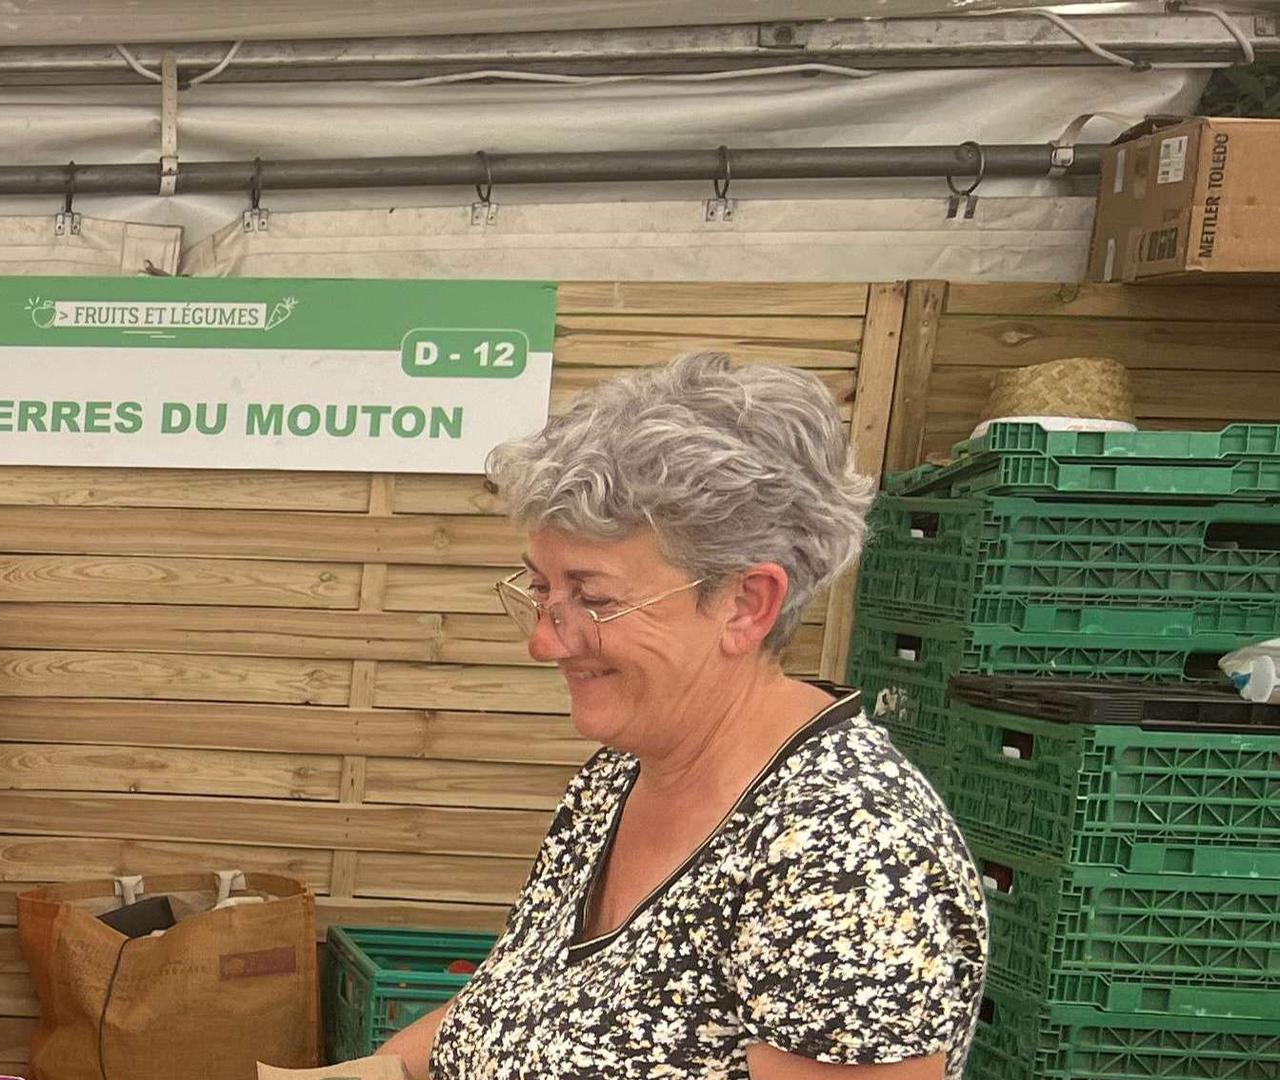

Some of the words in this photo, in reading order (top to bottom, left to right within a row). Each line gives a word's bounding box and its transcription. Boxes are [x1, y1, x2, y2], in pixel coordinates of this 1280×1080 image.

[1208, 133, 1229, 190] TOLEDO
[1198, 196, 1222, 258] METTLER
[73, 306, 140, 325] FRUITS
[144, 307, 167, 324] ET
[170, 303, 259, 326] LÉGUMES
[414, 341, 438, 366] D
[473, 341, 515, 367] 12
[160, 402, 228, 436] DU
[245, 403, 463, 439] MOUTON
